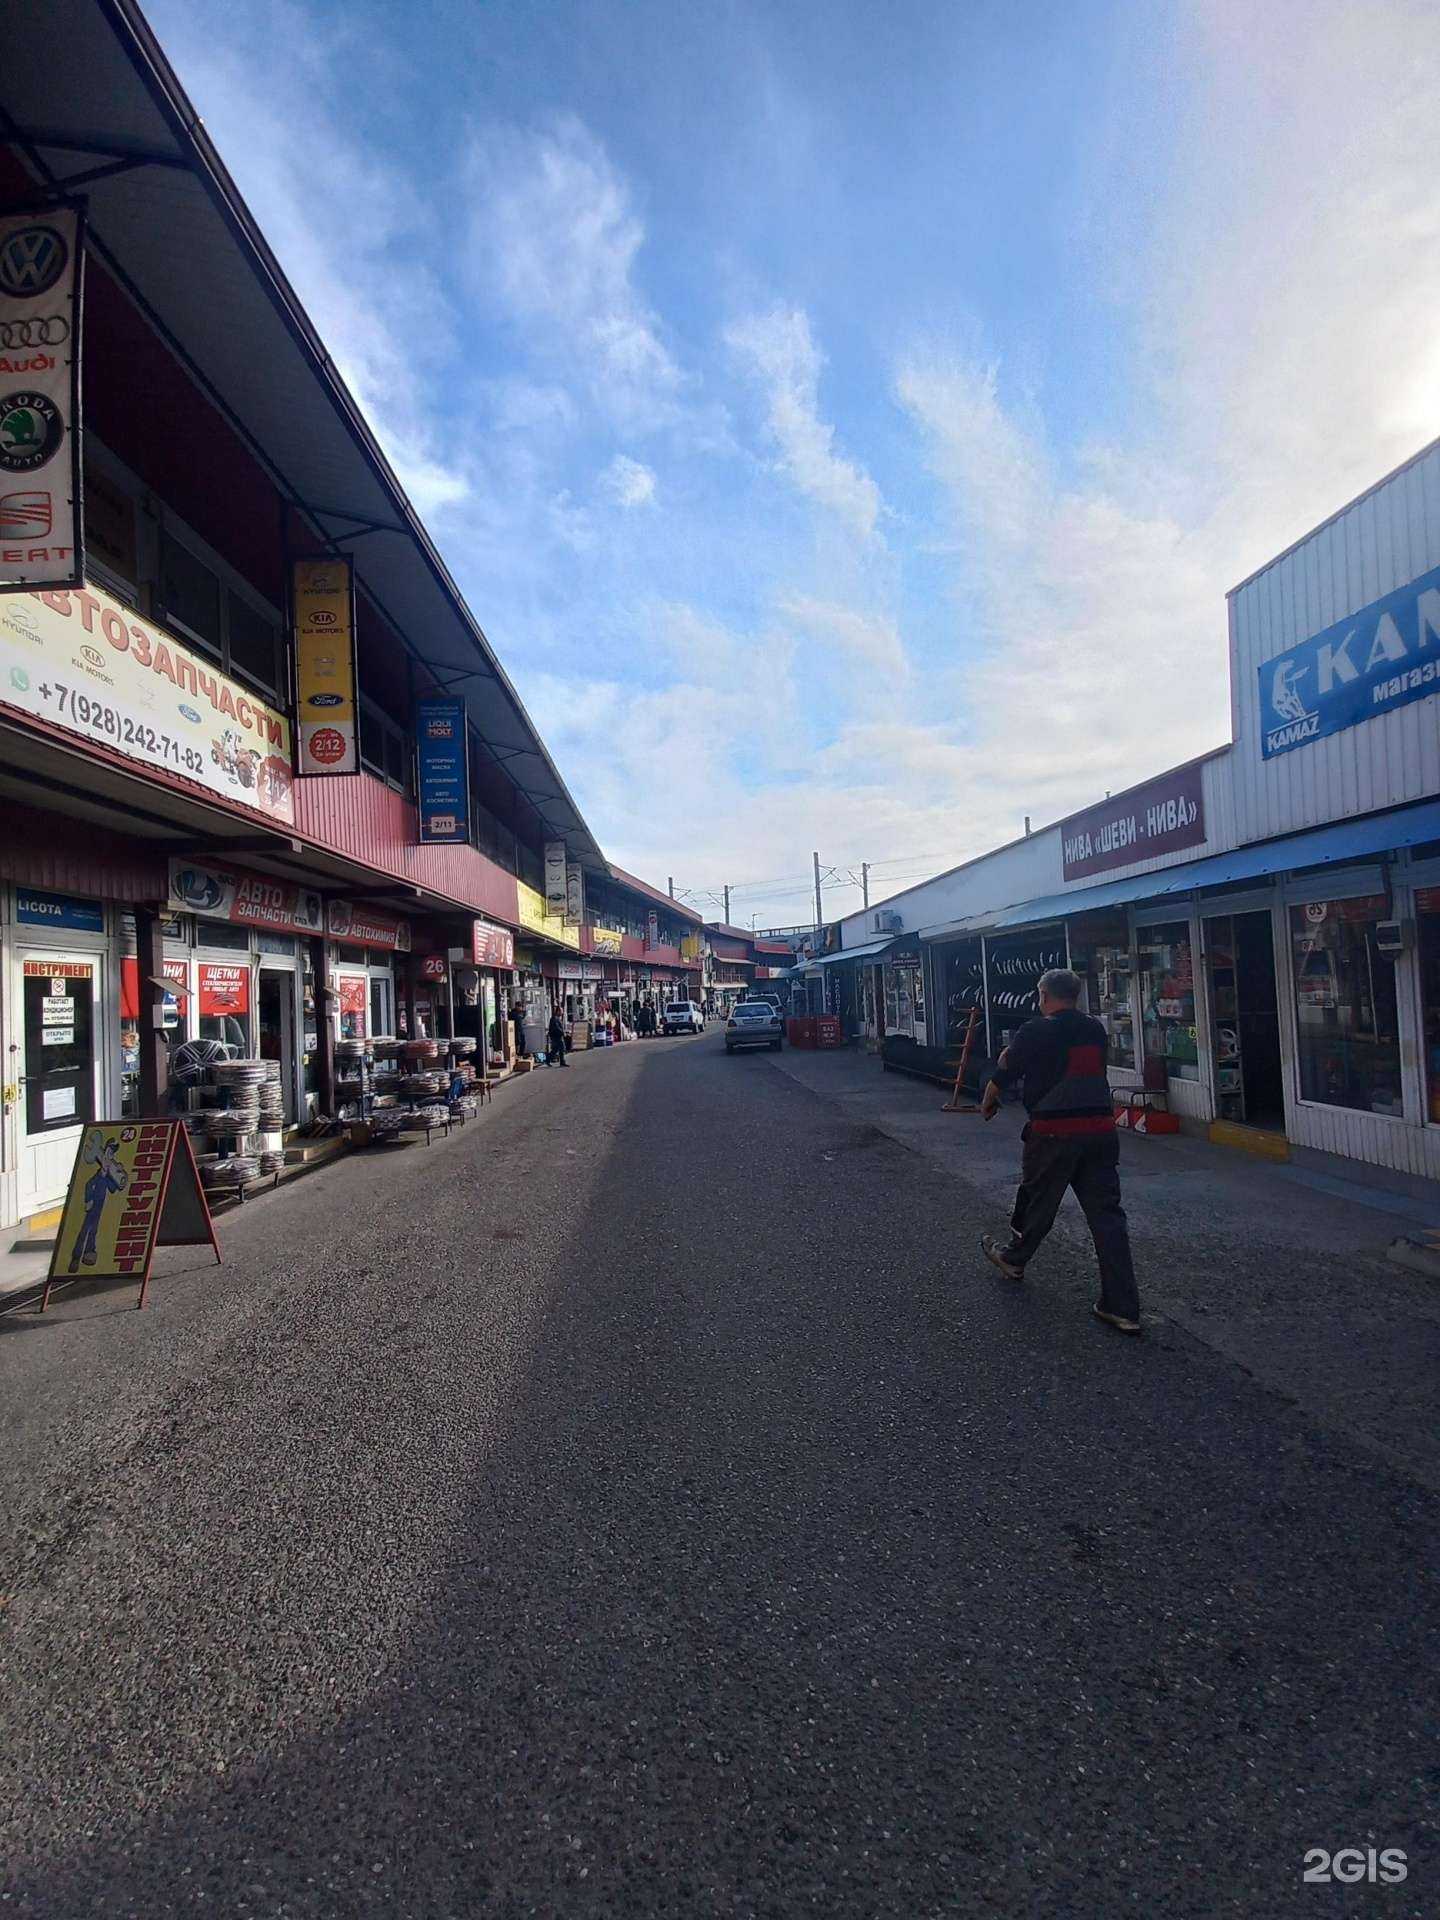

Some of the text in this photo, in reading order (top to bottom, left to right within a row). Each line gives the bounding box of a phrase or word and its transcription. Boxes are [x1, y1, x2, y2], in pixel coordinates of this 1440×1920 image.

[0, 395, 54, 420] KODA
[2, 617, 44, 645] HYUNDAI
[72, 657, 114, 686] KIA MOTORS
[1373, 659, 1440, 704] Магаз
[38, 682, 204, 775] +7(928)242-71-82
[1267, 715, 1320, 752] KAMAZ
[315, 738, 341, 751] 2/12
[1064, 833, 1093, 865] НИВА
[1094, 816, 1137, 855] «ШЕВИ
[1147, 796, 1197, 838] НИВА»
[238, 878, 284, 908] АВТО
[238, 902, 291, 924] ЗАПЧАСТИ
[351, 924, 395, 945] АВТОХИМИЯ
[23, 962, 91, 977] ИНСТРУМЕНТ
[206, 966, 240, 980] ЩЕТКИ
[426, 959, 444, 973] 26
[113, 1125, 170, 1272] ИНСТРУМЕНТ
